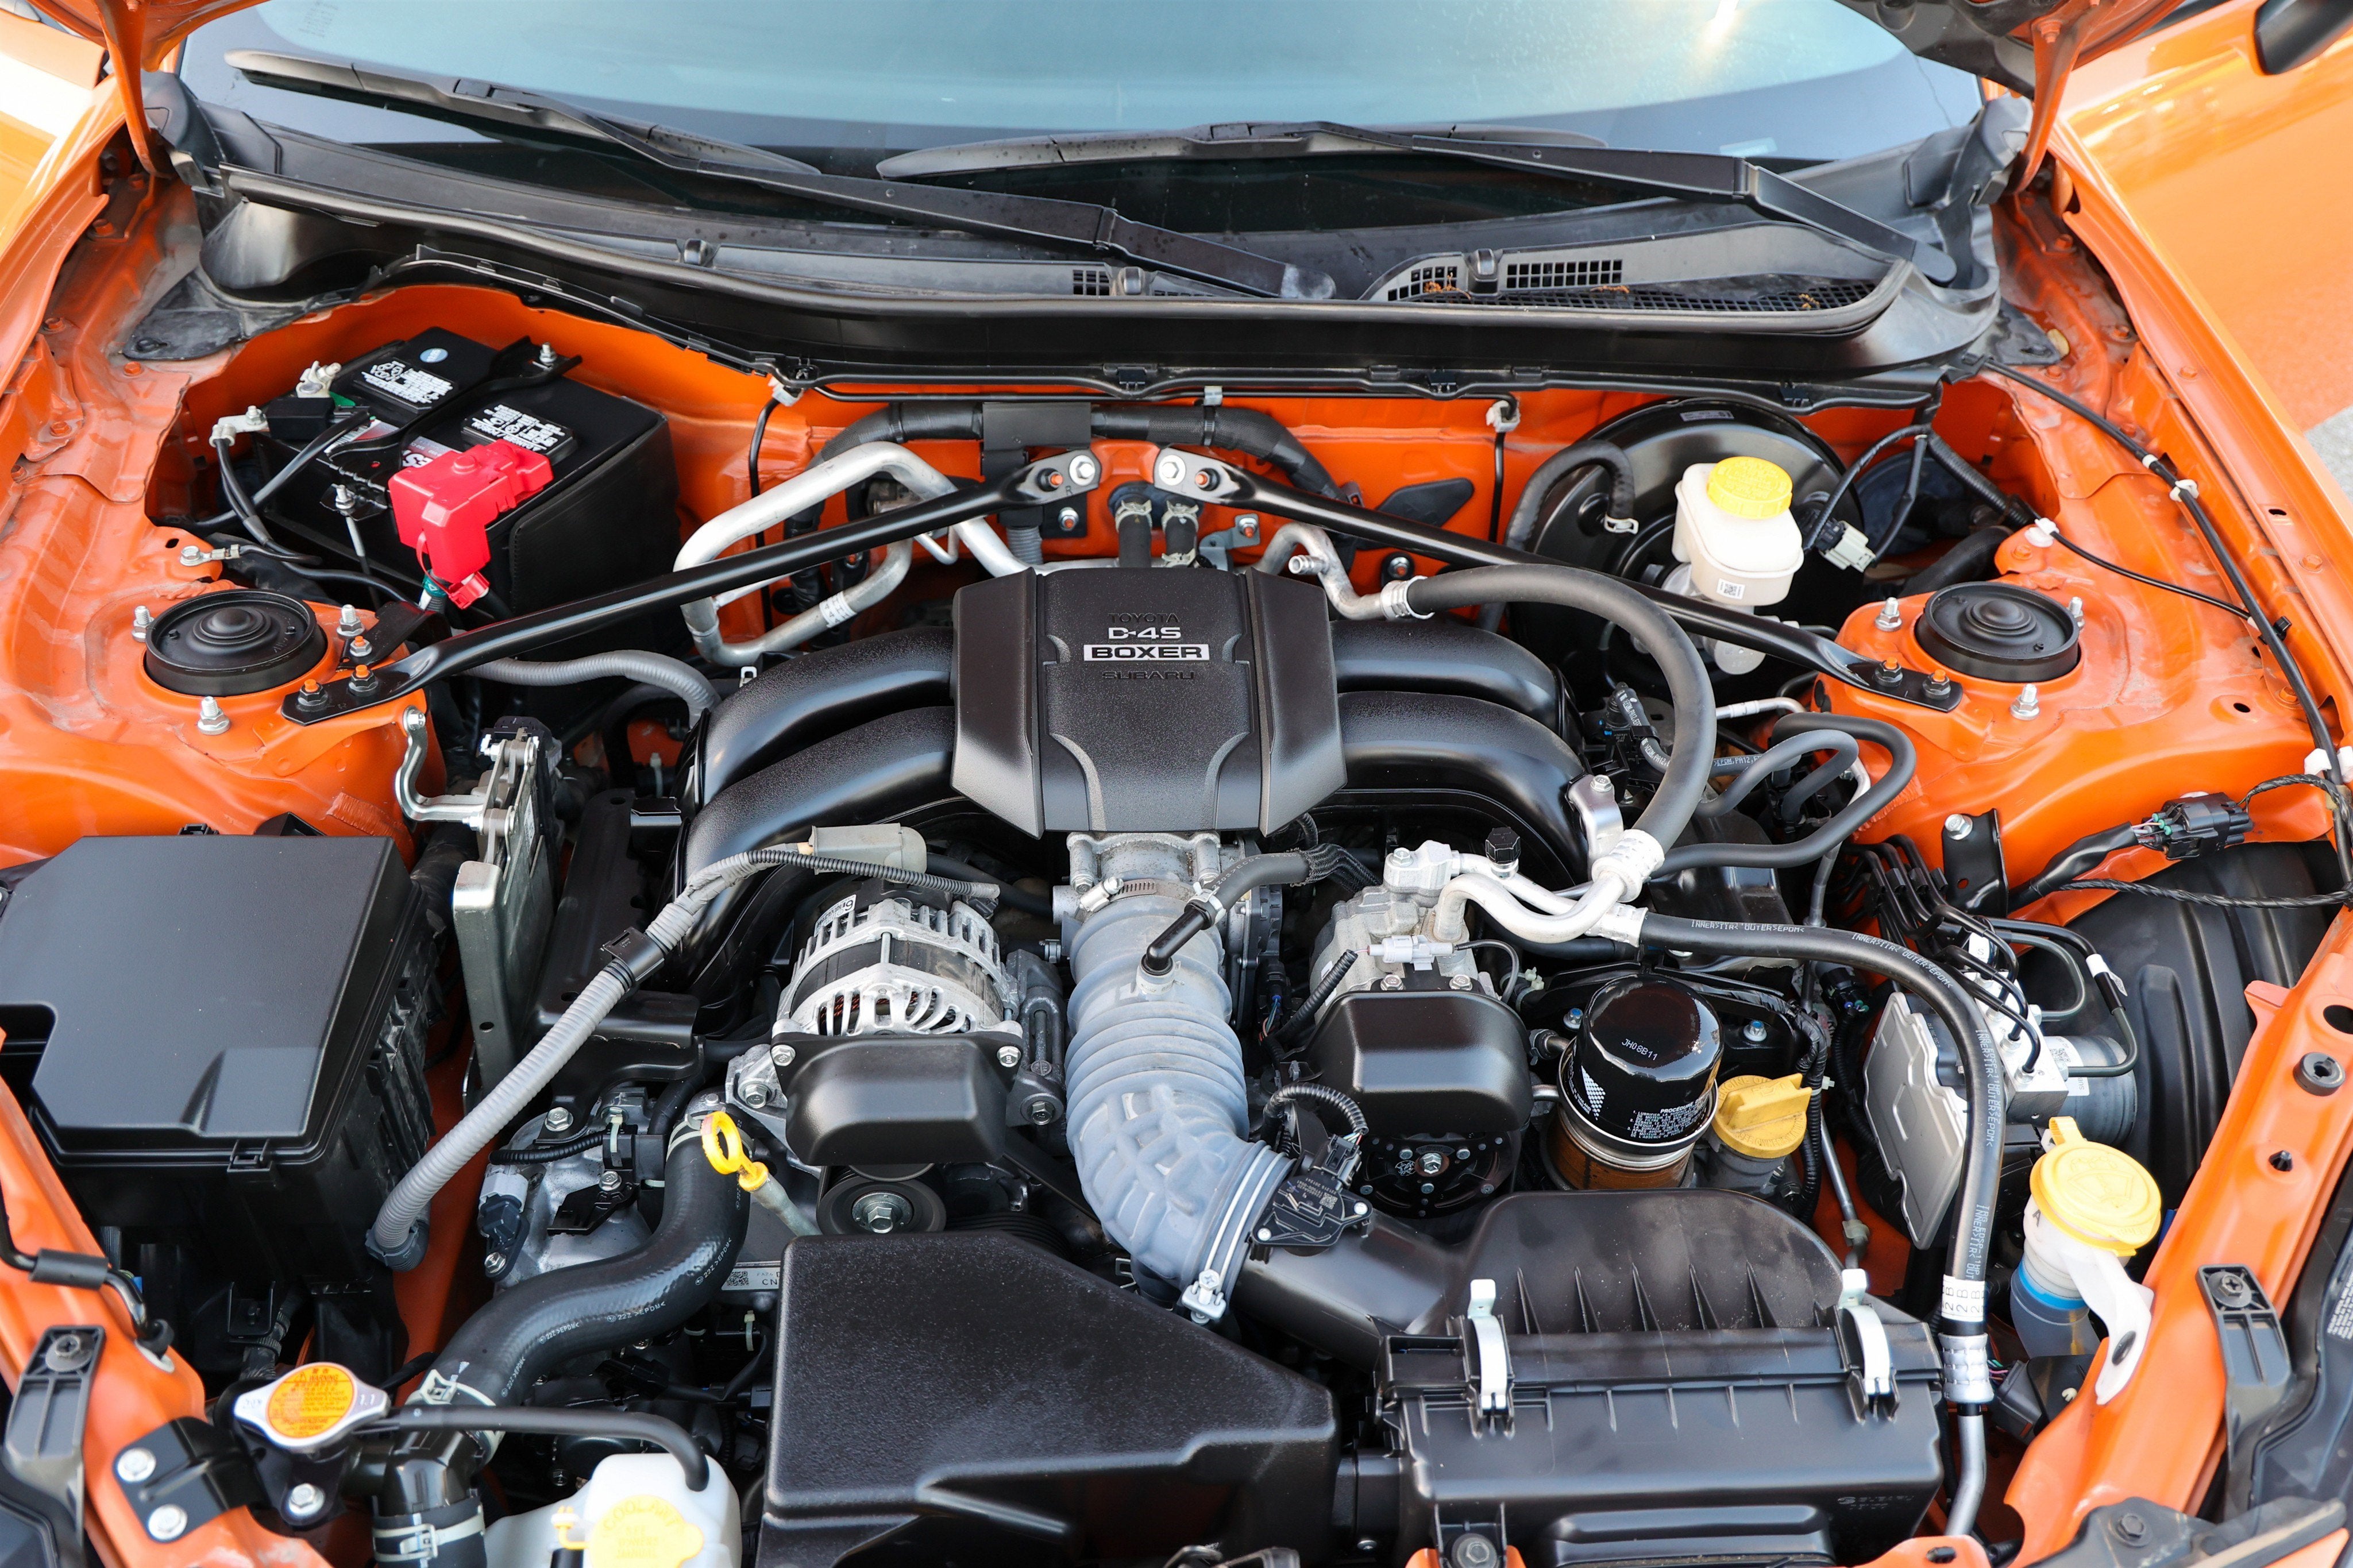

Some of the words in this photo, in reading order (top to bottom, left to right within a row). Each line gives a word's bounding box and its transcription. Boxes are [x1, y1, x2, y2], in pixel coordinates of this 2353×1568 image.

[1108, 613, 1180, 623] TOYOTA
[1108, 627, 1182, 639] D-4S
[1091, 647, 1202, 658] BOXER
[1102, 671, 1194, 680] SUBARU
[1622, 1038, 1658, 1061] JH08B11
